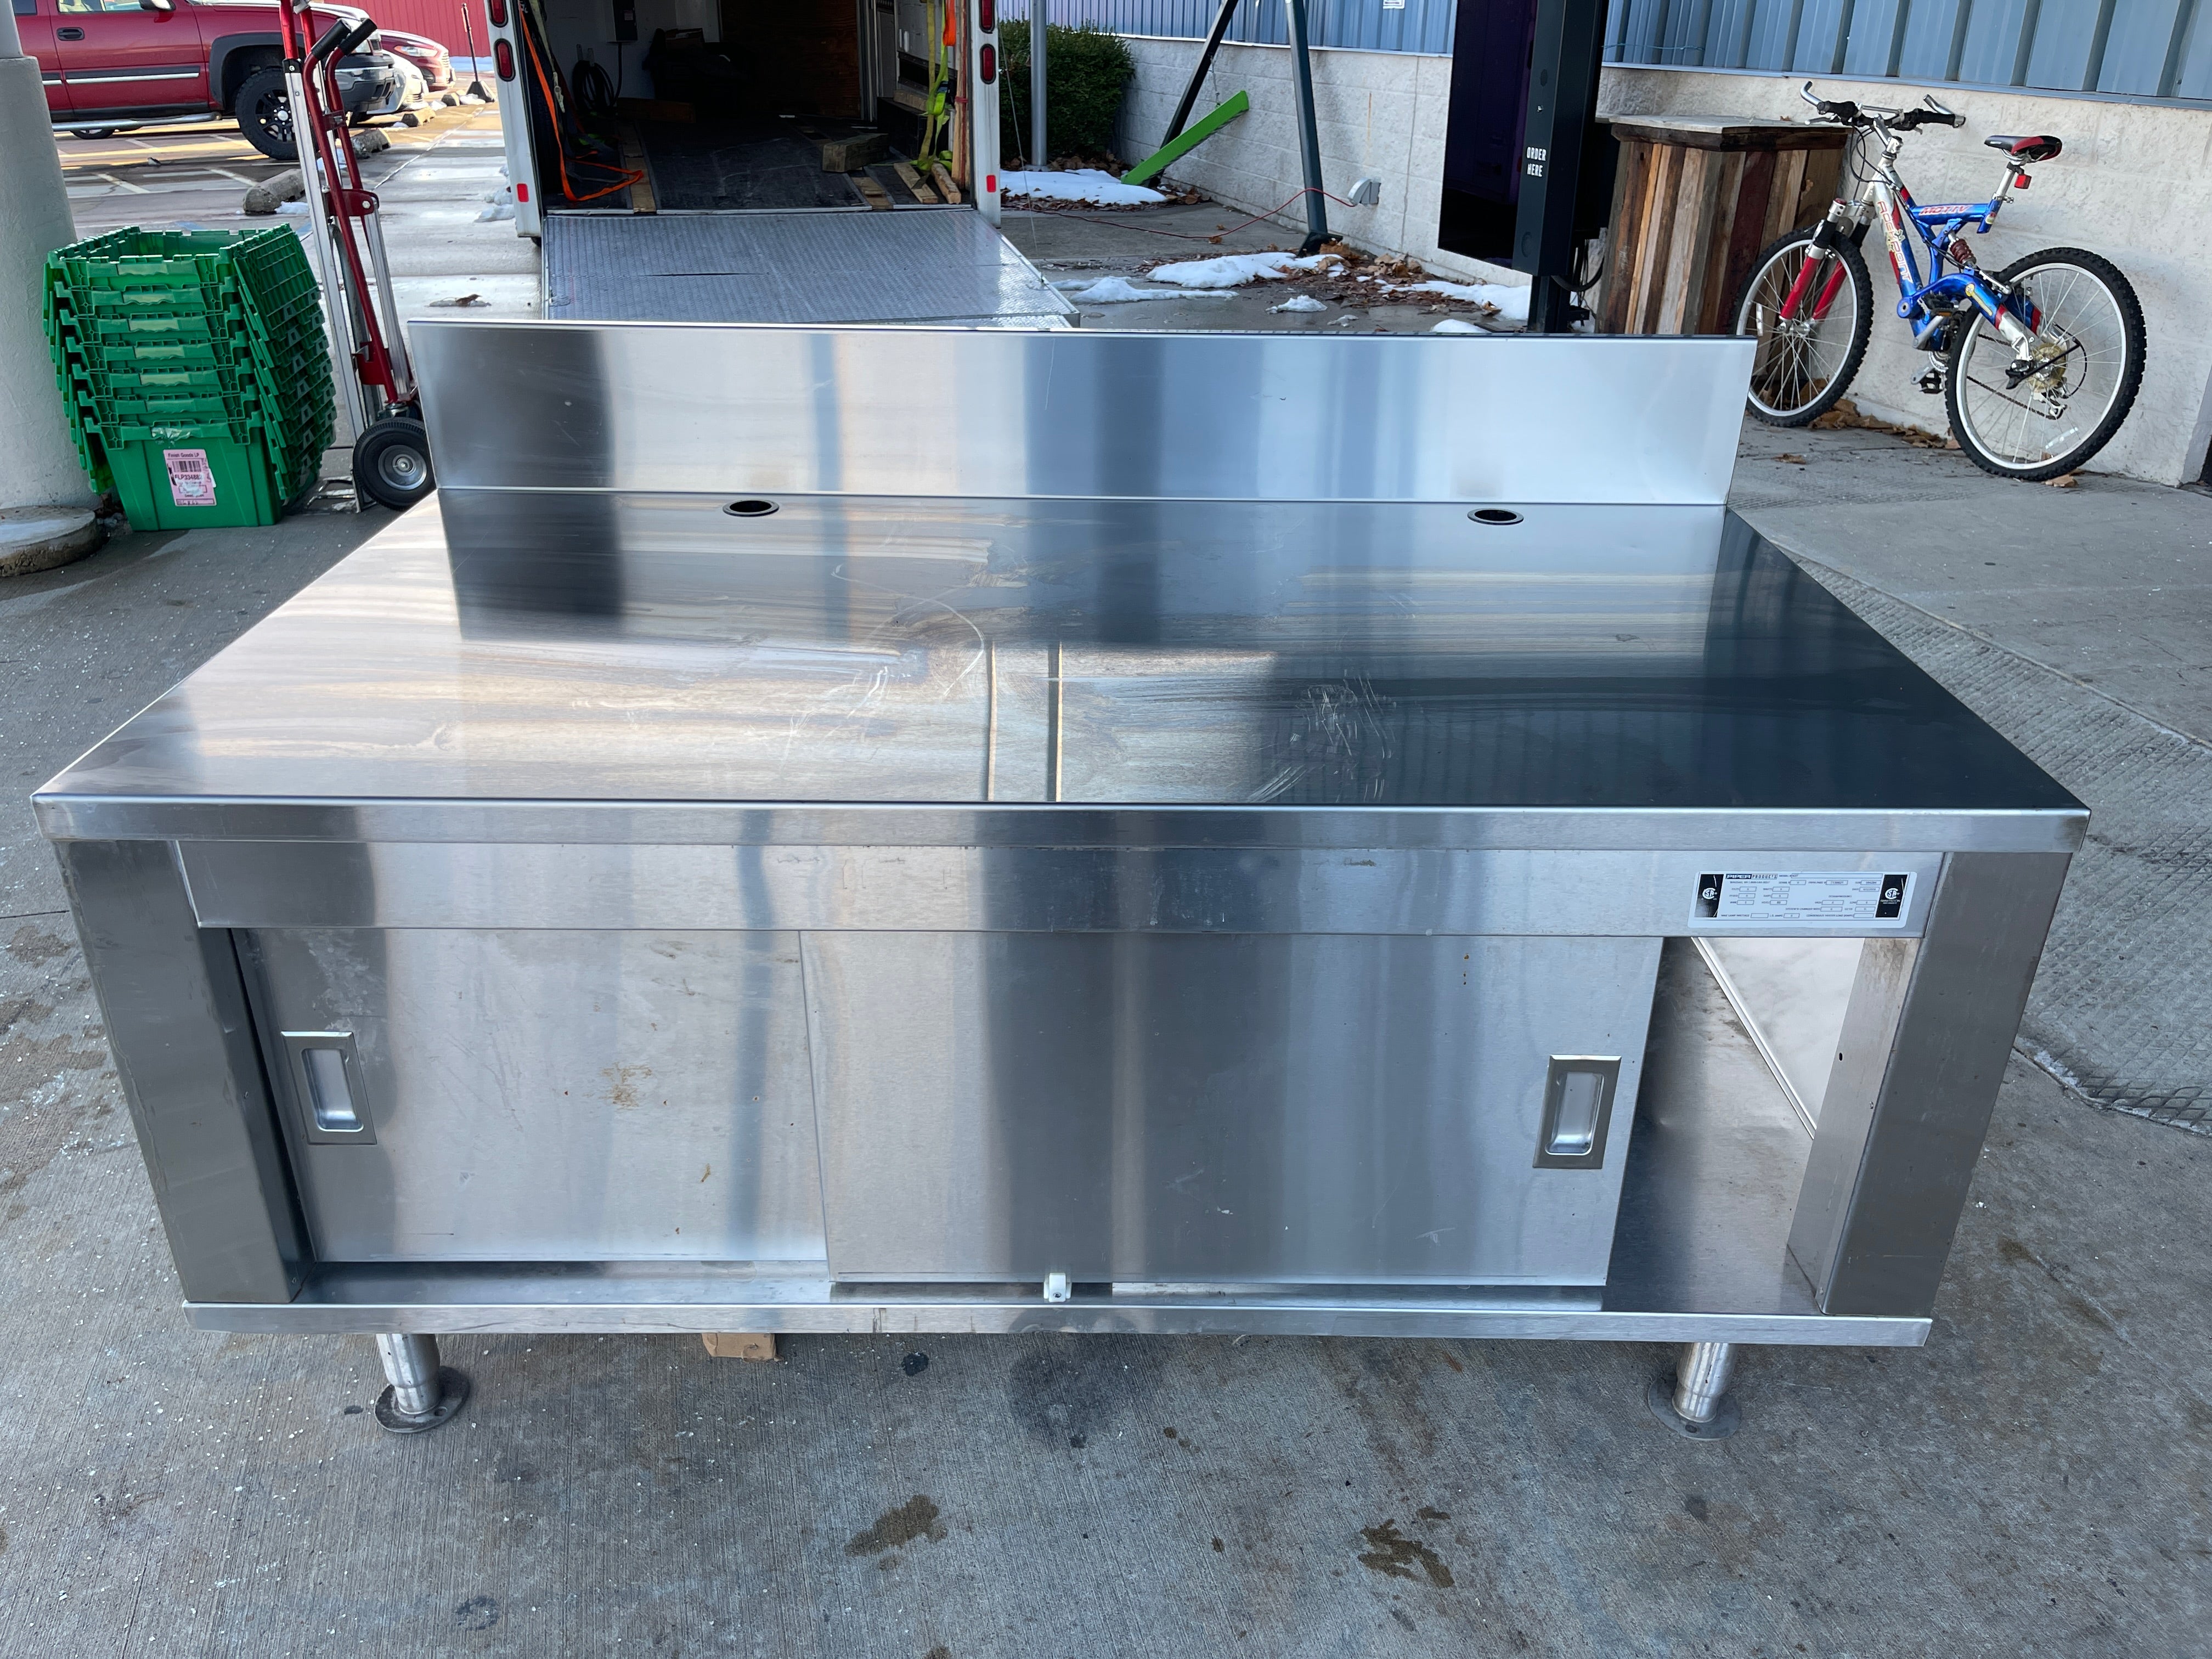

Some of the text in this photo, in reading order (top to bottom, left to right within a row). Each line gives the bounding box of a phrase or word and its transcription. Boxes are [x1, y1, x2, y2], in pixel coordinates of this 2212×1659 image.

[1526, 146, 1547, 161] ORDER
[1527, 163, 1543, 177] HERE
[1920, 205, 1971, 215] MOTIV
